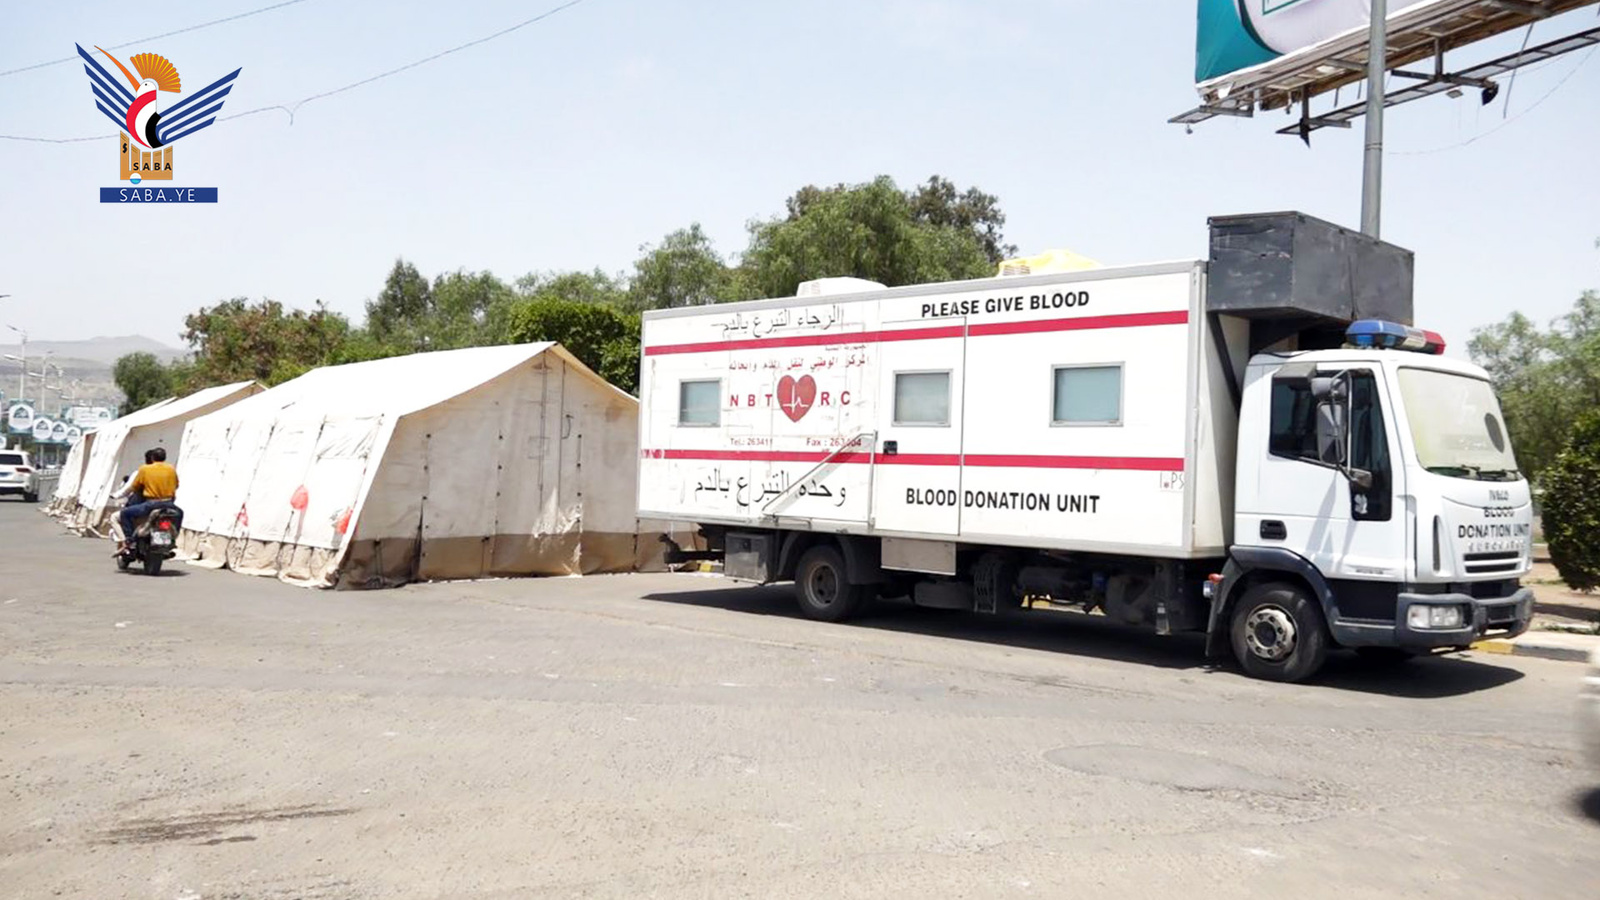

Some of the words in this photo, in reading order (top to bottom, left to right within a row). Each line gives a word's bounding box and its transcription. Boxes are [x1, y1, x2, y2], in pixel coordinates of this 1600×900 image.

[797, 304, 840, 331] الرجاء
[921, 300, 980, 318] PLEASE
[985, 296, 1024, 313] GIVE
[1030, 291, 1090, 310] BLOOD
[753, 308, 791, 338] التبرع
[694, 467, 731, 503] بالدم
[906, 488, 957, 507] BLOOD
[964, 490, 1050, 511] DONATION
[1056, 494, 1100, 513] UNIT
[1458, 524, 1512, 538] DONATION
